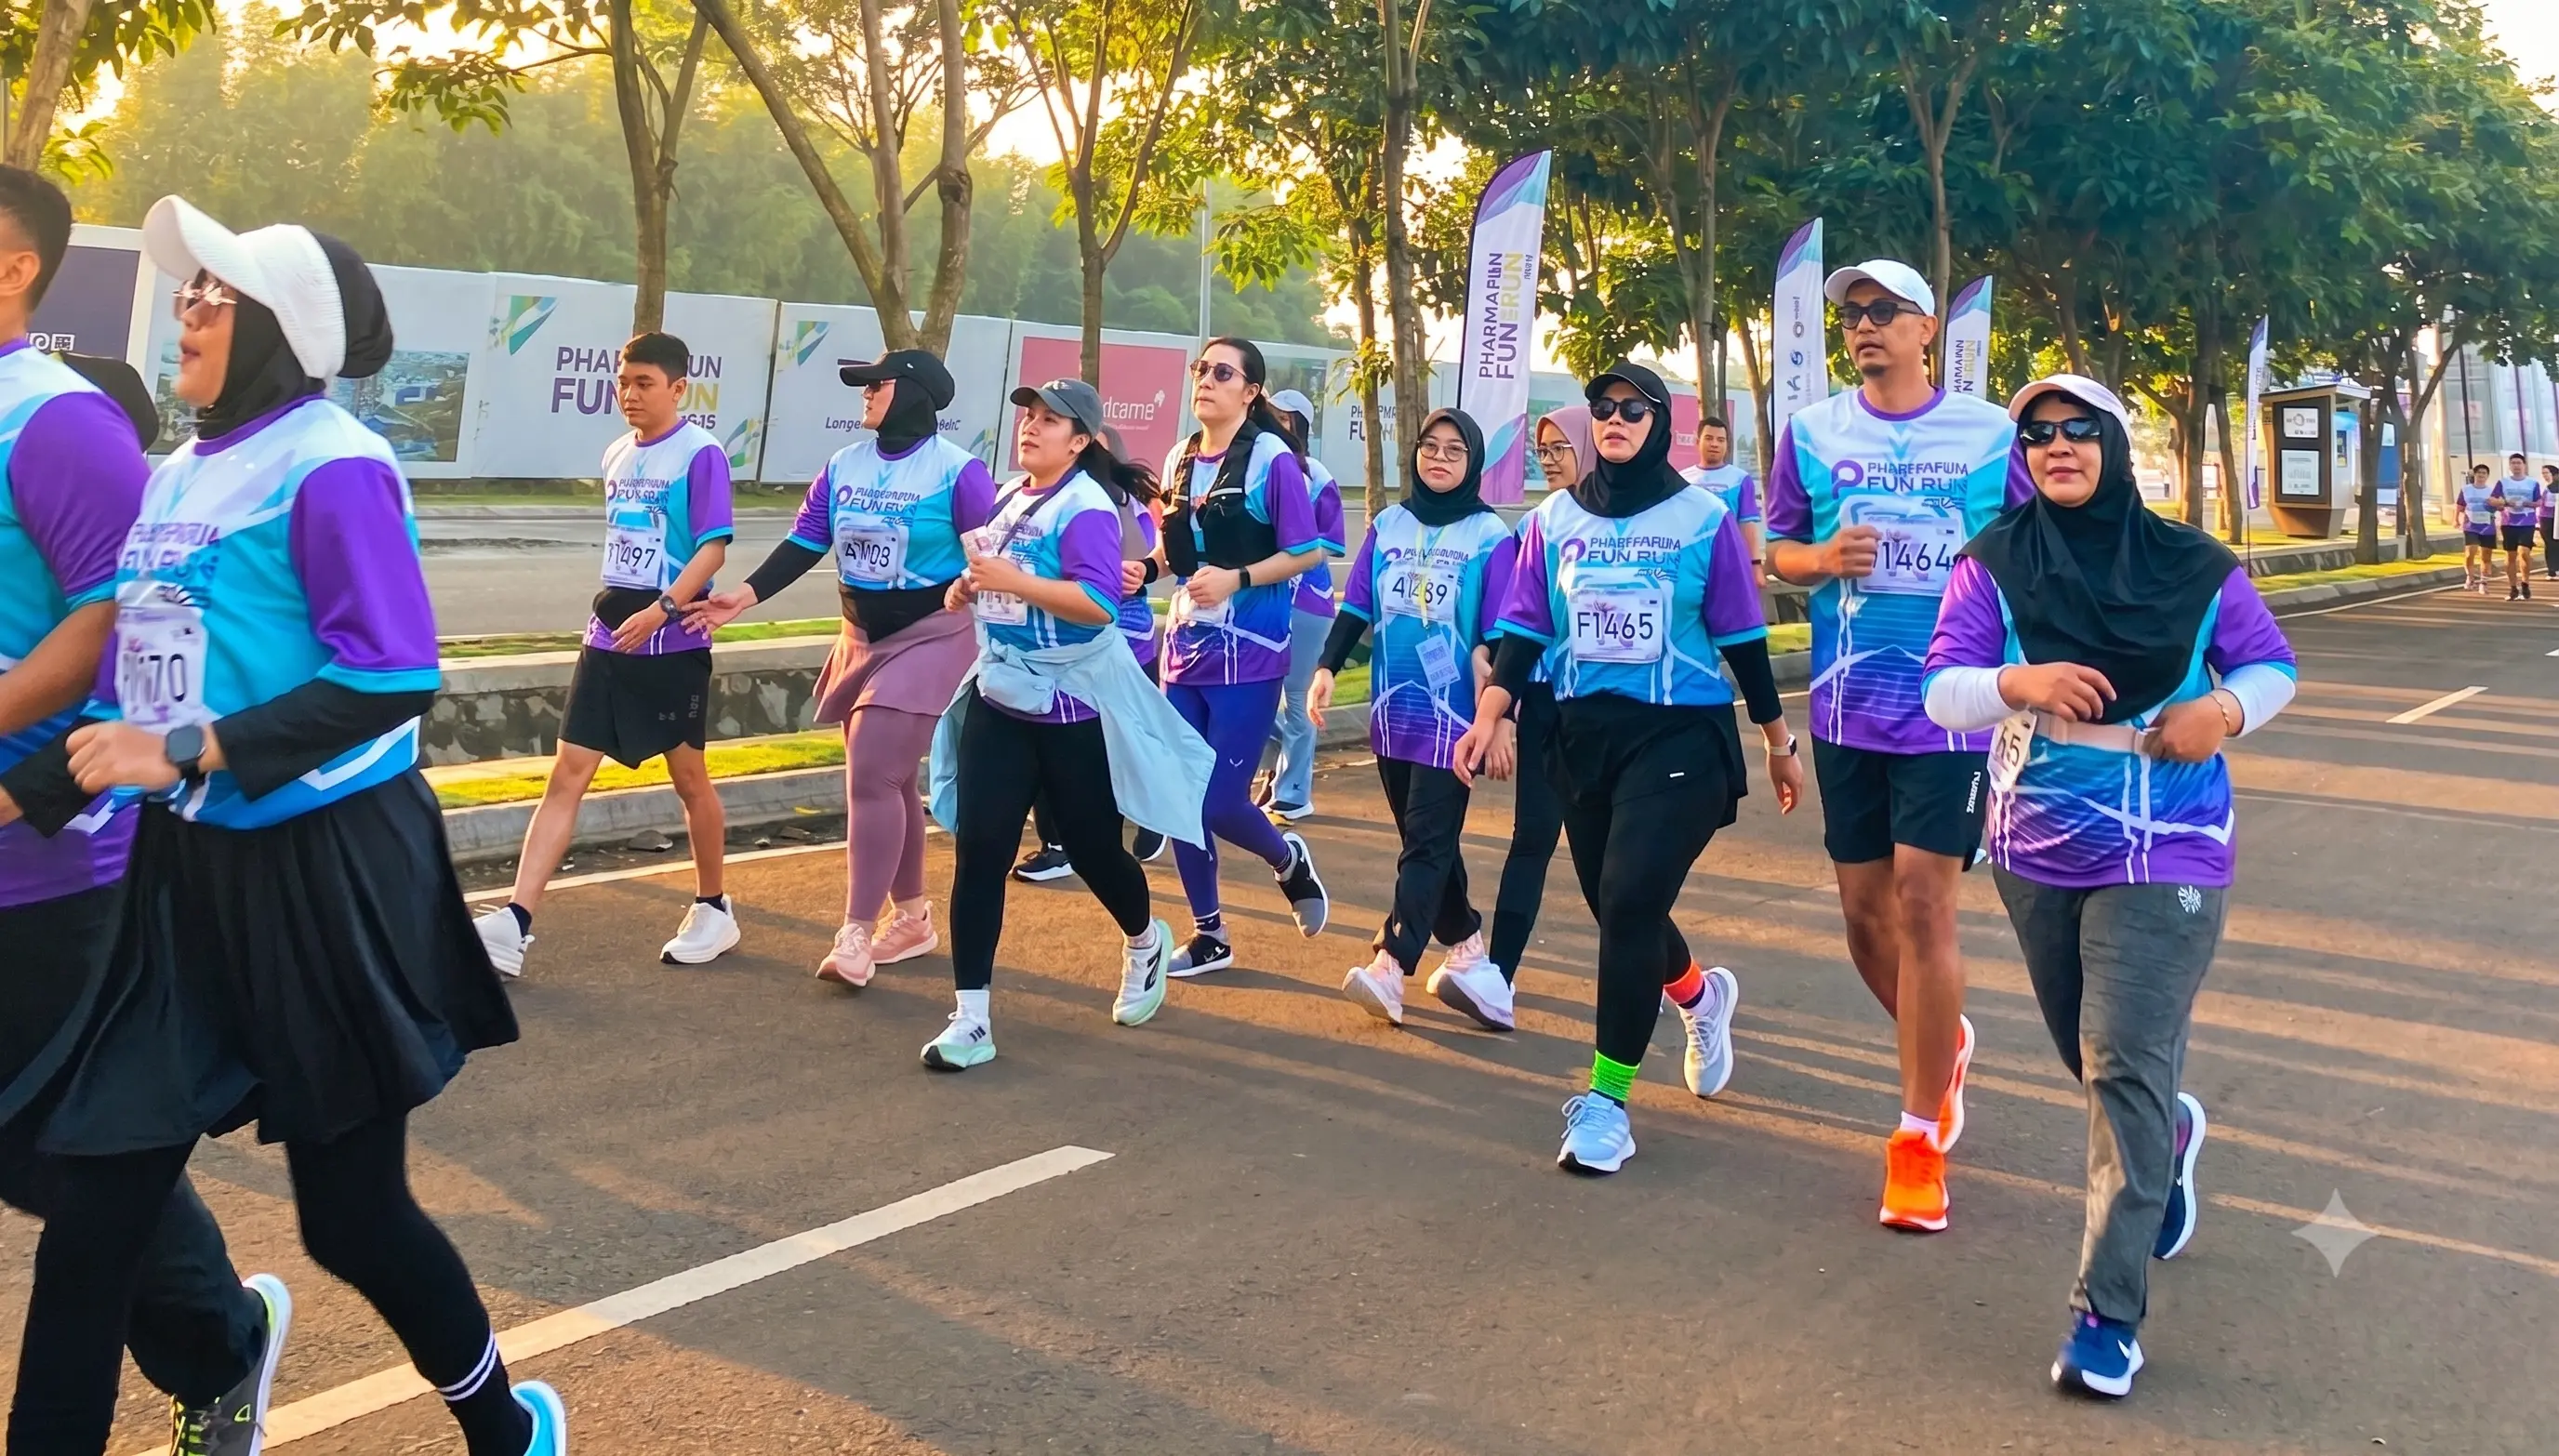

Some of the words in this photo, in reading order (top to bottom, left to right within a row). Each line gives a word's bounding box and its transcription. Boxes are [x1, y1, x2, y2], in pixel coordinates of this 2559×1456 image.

[1867, 475, 1915, 493] FUN
[1587, 549, 1631, 564] FUN
[1873, 542, 1955, 572] 1464
[1577, 611, 1653, 641] F1465
